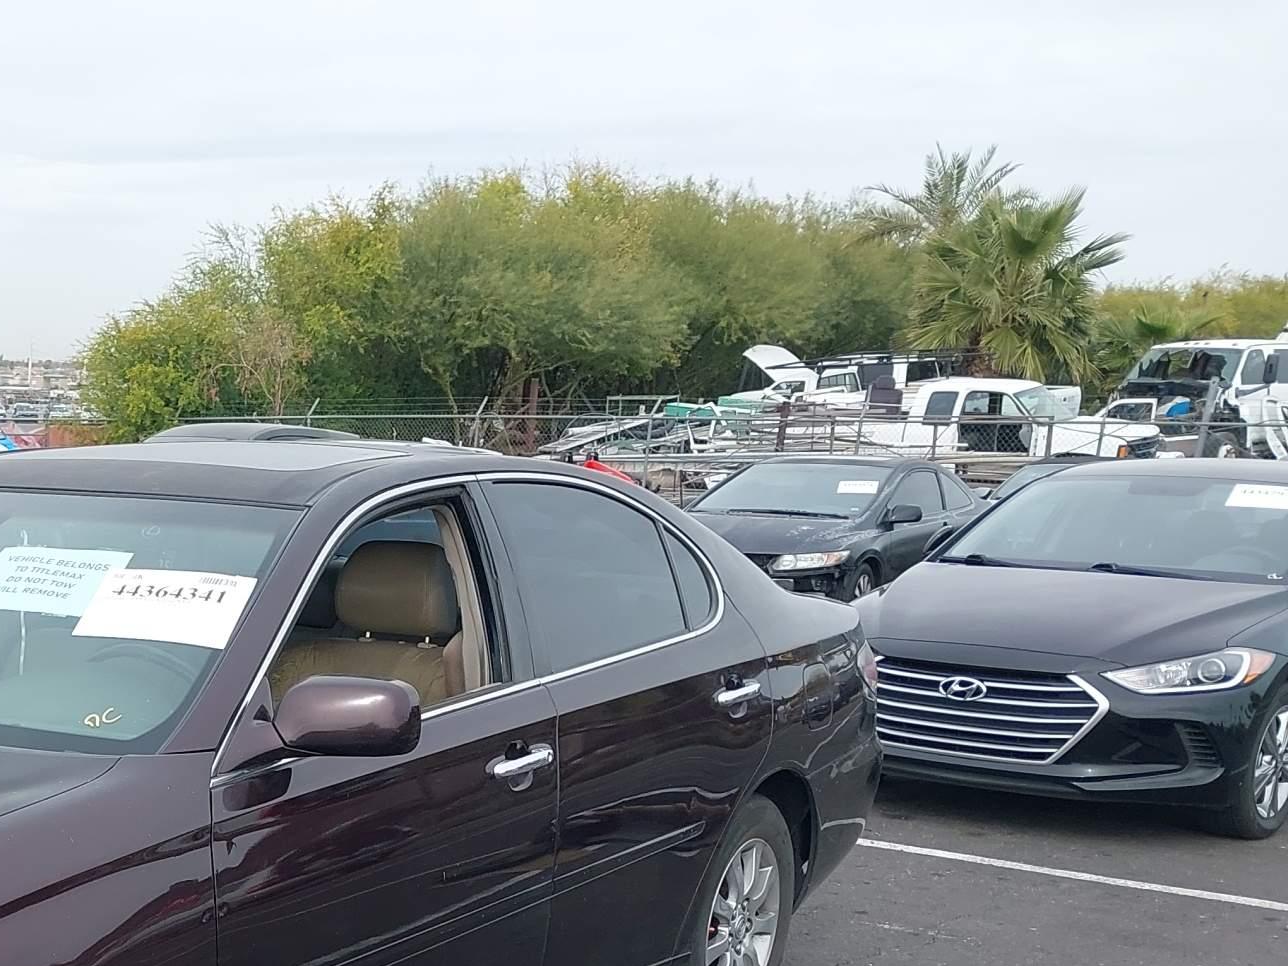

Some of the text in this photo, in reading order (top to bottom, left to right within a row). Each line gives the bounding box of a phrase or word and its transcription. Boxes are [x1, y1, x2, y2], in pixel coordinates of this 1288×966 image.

[8, 555, 112, 572] VEHICLE BELONGS
[15, 565, 85, 580] TO TITLEMAX
[6, 575, 77, 590] DO NOT TOW
[22, 587, 72, 600] REMOVE
[112, 584, 227, 603] 44364341
